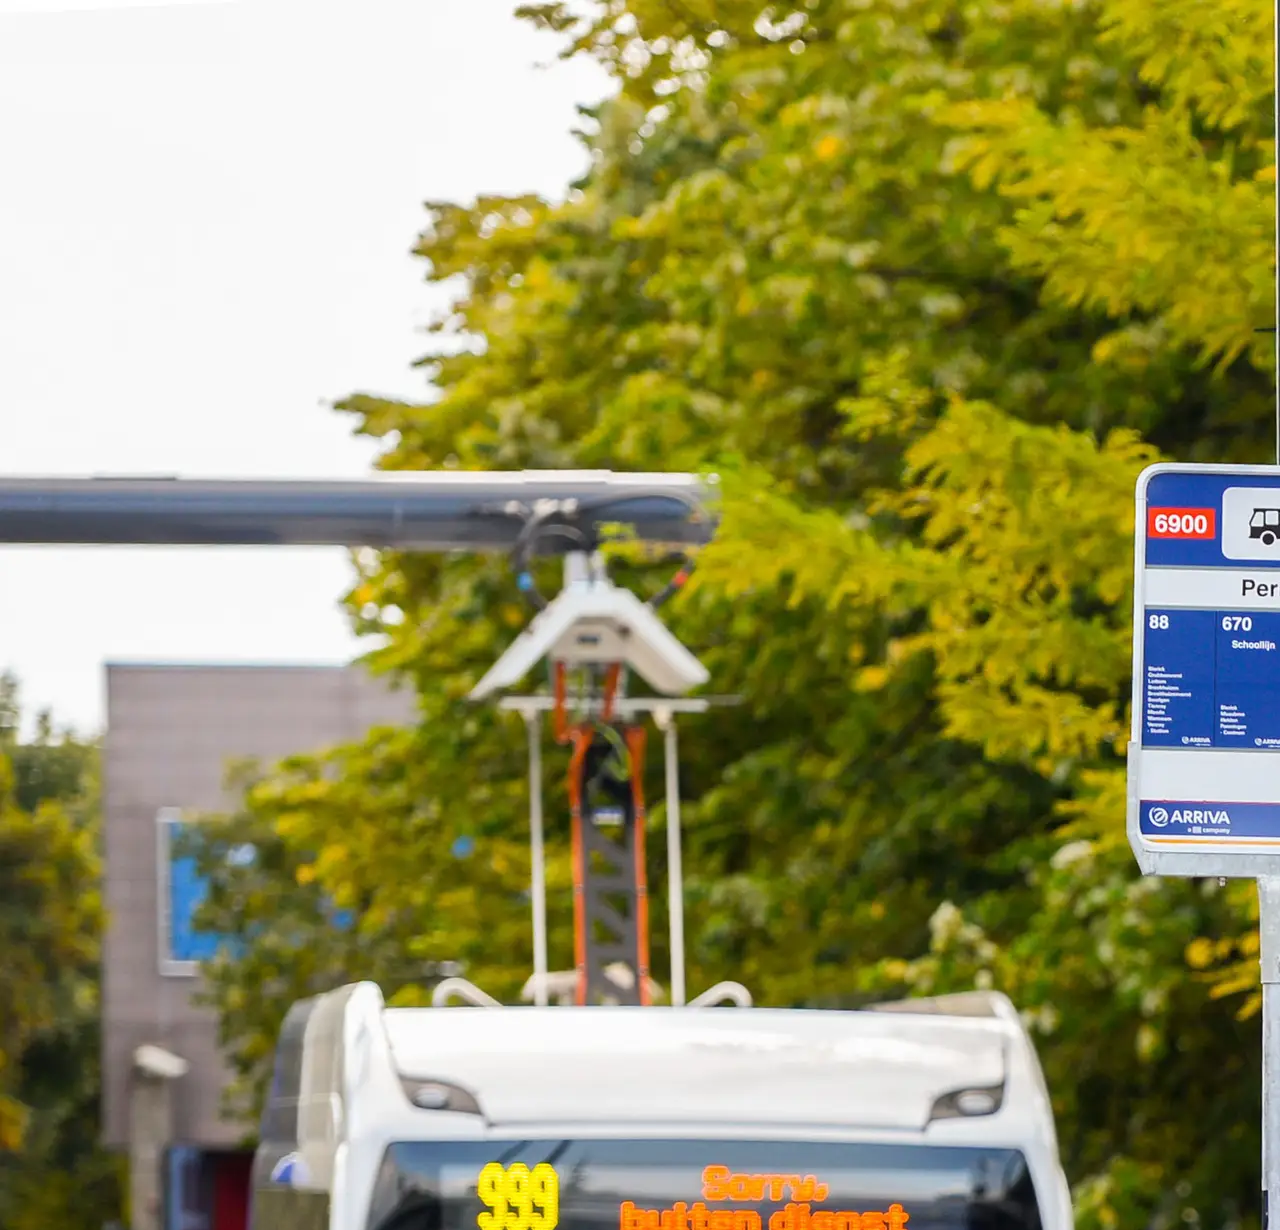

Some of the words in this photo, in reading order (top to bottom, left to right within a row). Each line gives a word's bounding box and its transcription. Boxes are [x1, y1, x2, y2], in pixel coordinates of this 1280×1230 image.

[1154, 513, 1208, 534] 6900
[1148, 614, 1170, 630] 88
[1221, 616, 1253, 632] 670
[1170, 810, 1231, 825] ARRIVA
[702, 1164, 829, 1201] Sorry,
